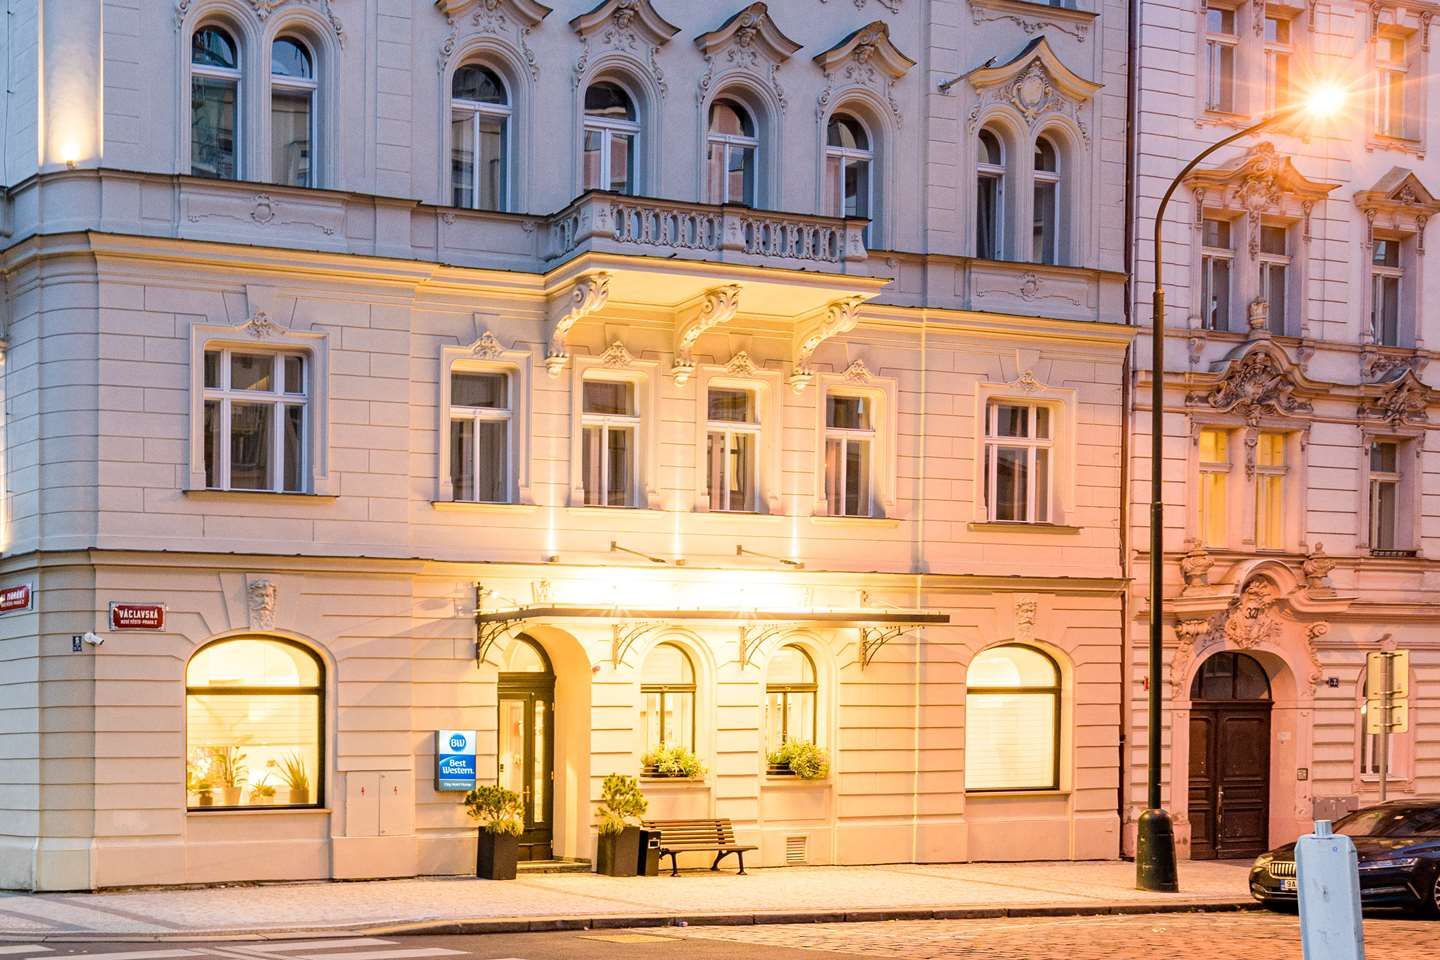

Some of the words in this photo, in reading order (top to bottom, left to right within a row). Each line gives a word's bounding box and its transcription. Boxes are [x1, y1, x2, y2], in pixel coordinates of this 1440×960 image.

[119, 608, 158, 618] VÁCLAVSKÁ
[450, 738, 465, 748] BW
[449, 759, 466, 767] Best
[442, 766, 473, 775] Western
